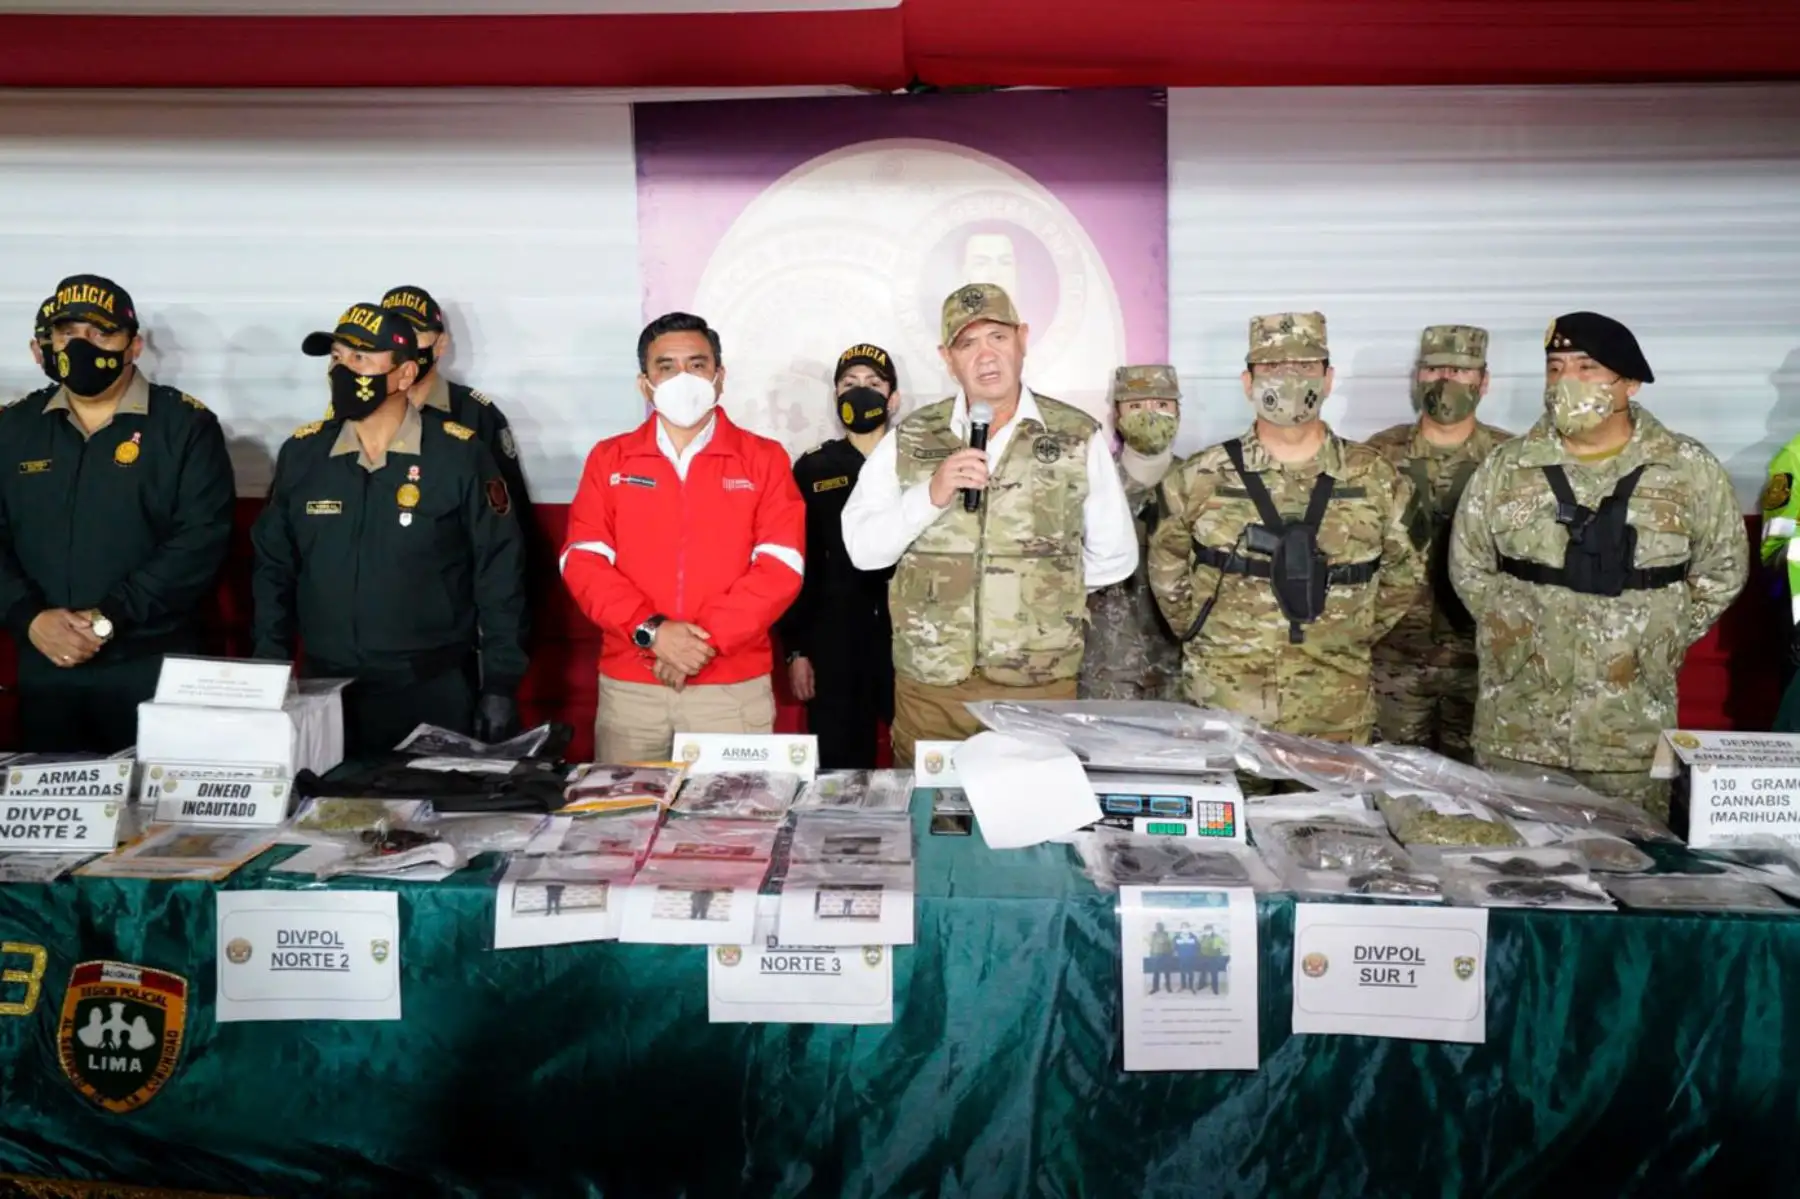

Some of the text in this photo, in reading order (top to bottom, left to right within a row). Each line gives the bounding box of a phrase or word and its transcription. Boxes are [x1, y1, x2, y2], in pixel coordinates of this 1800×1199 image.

[57, 283, 115, 314] POLICIA
[841, 345, 887, 367] POLICIA
[722, 747, 770, 759] ARMAS
[38, 769, 101, 785] ARMAS
[1712, 778, 1736, 791] 130
[197, 783, 252, 798] DINERO
[181, 800, 257, 817] INCAUTADO
[1711, 795, 1791, 807] CANNABIS
[6, 807, 84, 821] DIVPOL
[1710, 811, 1800, 825] (MARIHUAN
[0, 825, 88, 839] NORTE 2
[277, 929, 345, 945] DIVPOL
[271, 952, 350, 969] NORTE 2
[1354, 945, 1426, 962] DIVPOL
[760, 956, 841, 972] NORTE 3
[1360, 967, 1415, 984] SUR 1
[88, 1053, 143, 1073] LIMA
